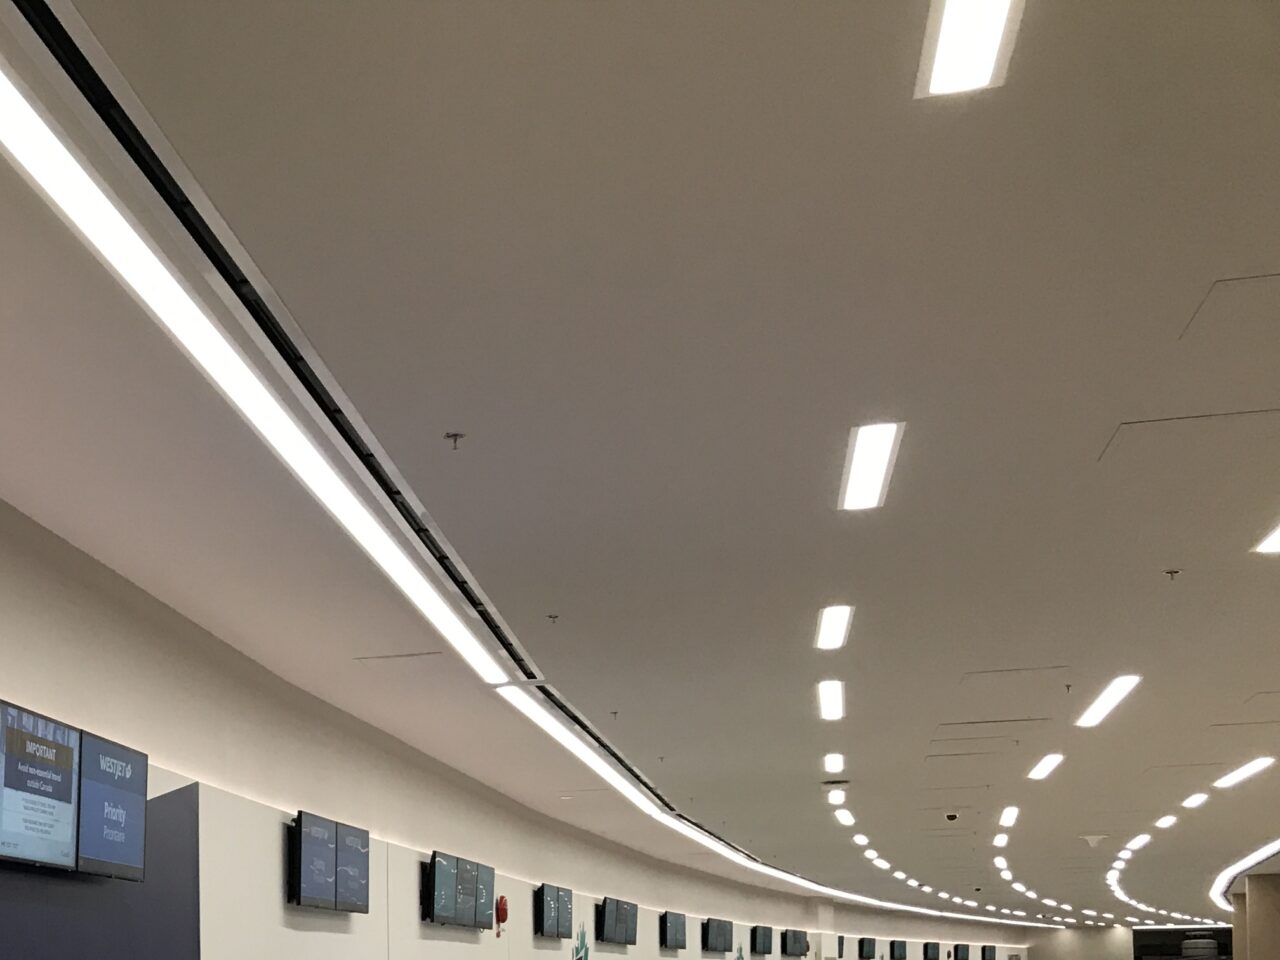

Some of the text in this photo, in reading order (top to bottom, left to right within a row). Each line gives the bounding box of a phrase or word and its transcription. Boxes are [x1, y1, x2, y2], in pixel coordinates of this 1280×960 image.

[25, 740, 56, 761] IMPORTANT
[99, 754, 126, 780] WESTJET
[103, 801, 126, 828] Priority
